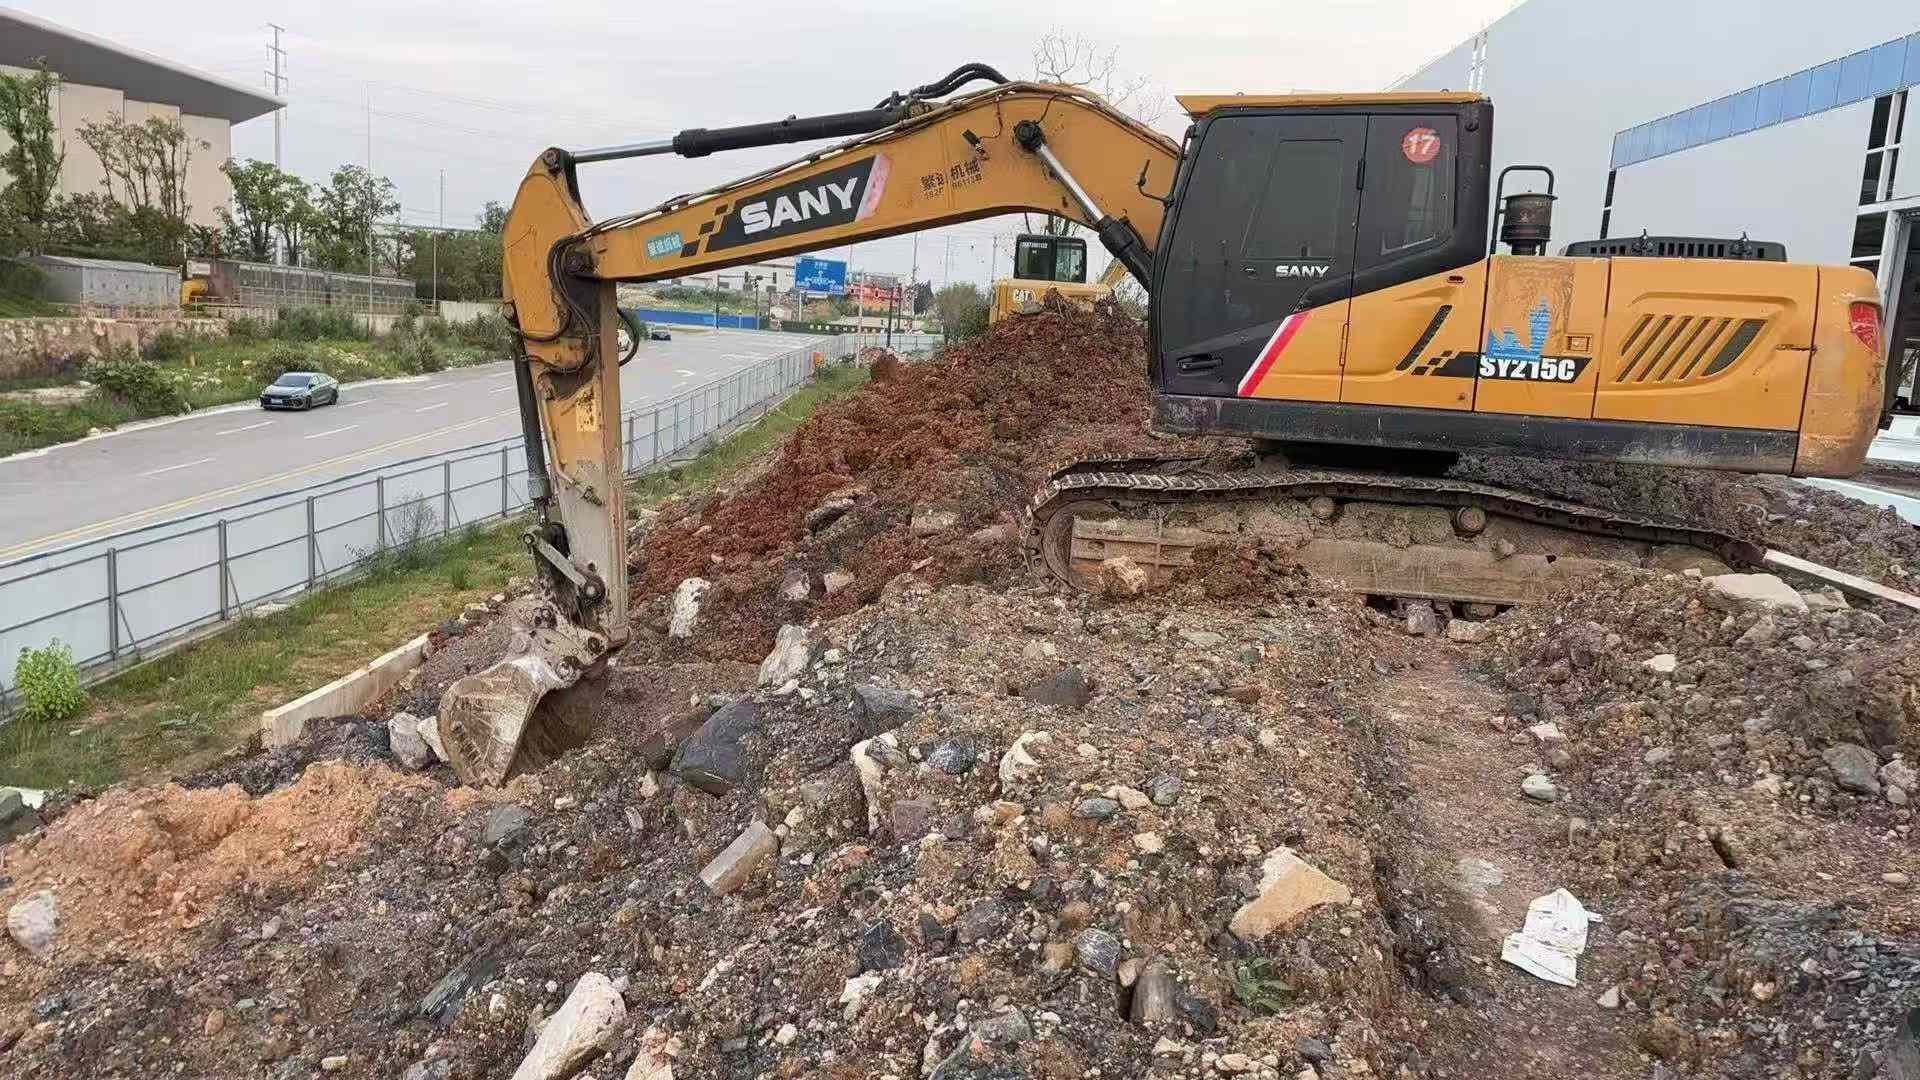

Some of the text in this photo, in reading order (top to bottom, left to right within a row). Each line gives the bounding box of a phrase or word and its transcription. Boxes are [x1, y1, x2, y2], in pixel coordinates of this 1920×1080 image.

[1408, 134, 1435, 155] 17
[740, 177, 858, 235] SANY
[1275, 265, 1329, 278] SANY
[1479, 355, 1576, 381] SY215C
